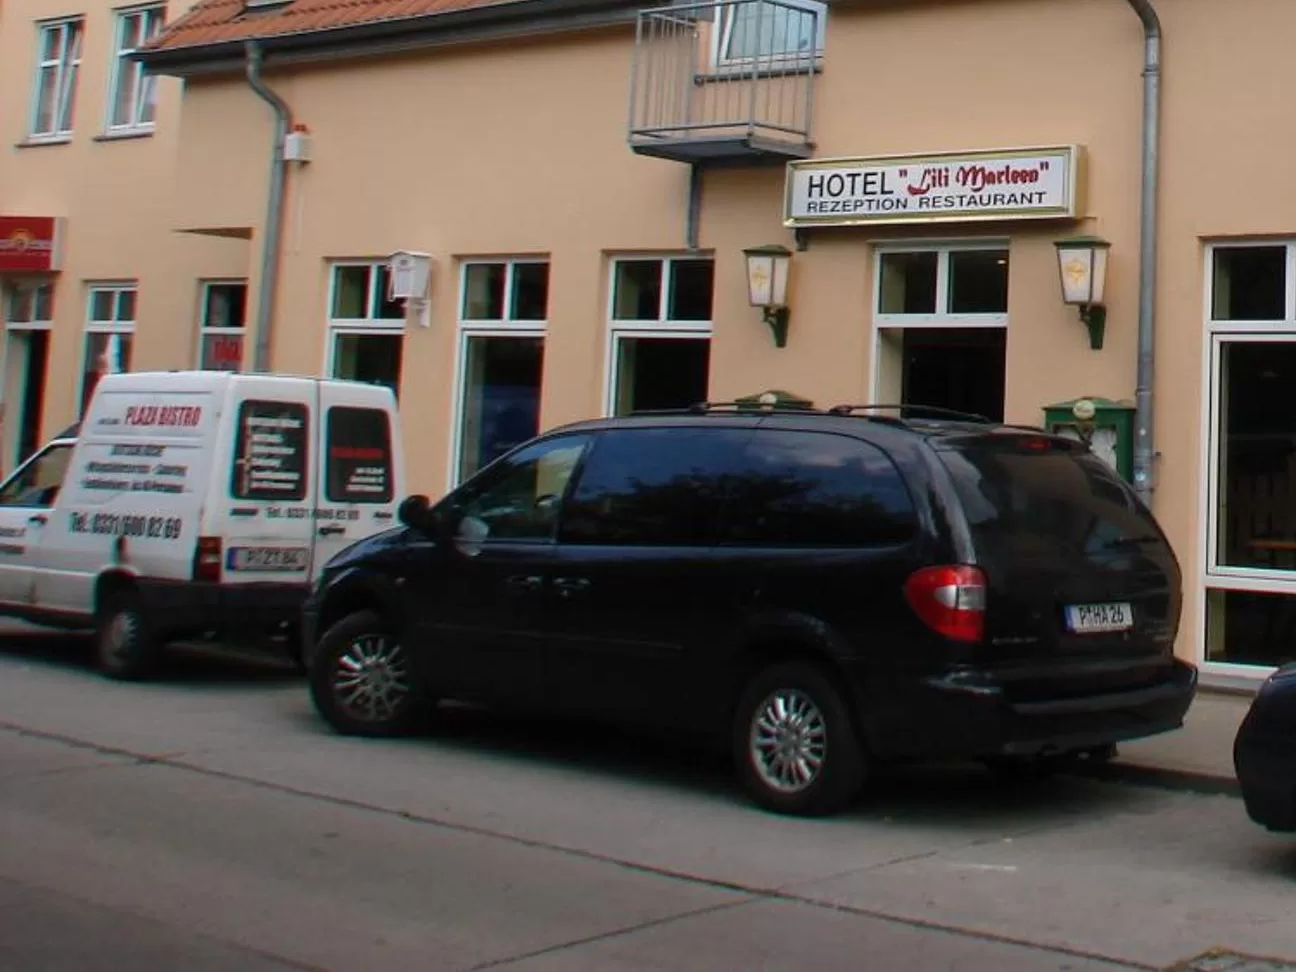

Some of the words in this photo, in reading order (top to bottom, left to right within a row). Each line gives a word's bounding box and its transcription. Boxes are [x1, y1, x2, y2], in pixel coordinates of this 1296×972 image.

[808, 171, 894, 198] HOTEL
[807, 197, 908, 213] REZEPTION
[919, 191, 1047, 209] RESTAURANT
[124, 406, 158, 425] PLAZA
[158, 406, 202, 427] BISTRO
